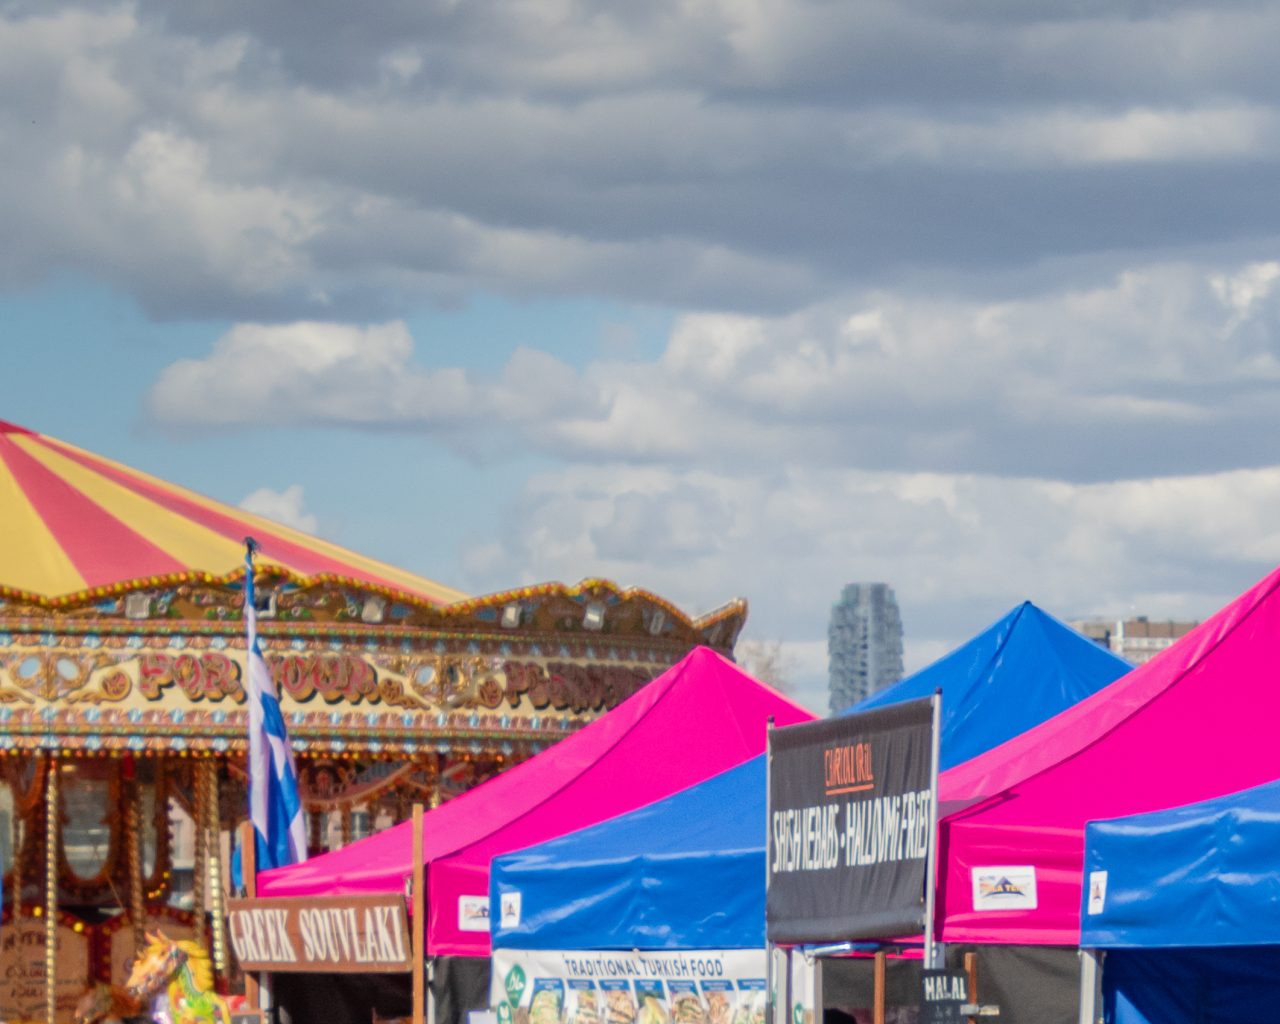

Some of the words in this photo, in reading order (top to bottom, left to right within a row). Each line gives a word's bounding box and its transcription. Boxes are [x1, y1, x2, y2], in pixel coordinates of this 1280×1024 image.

[229, 909, 297, 962] GREEK
[299, 905, 406, 963] SOUVLAKI
[565, 959, 640, 976] TRADITIONAL
[641, 959, 688, 977] TURKISH
[691, 959, 724, 977] FOOD
[925, 975, 967, 1001] HALAL
